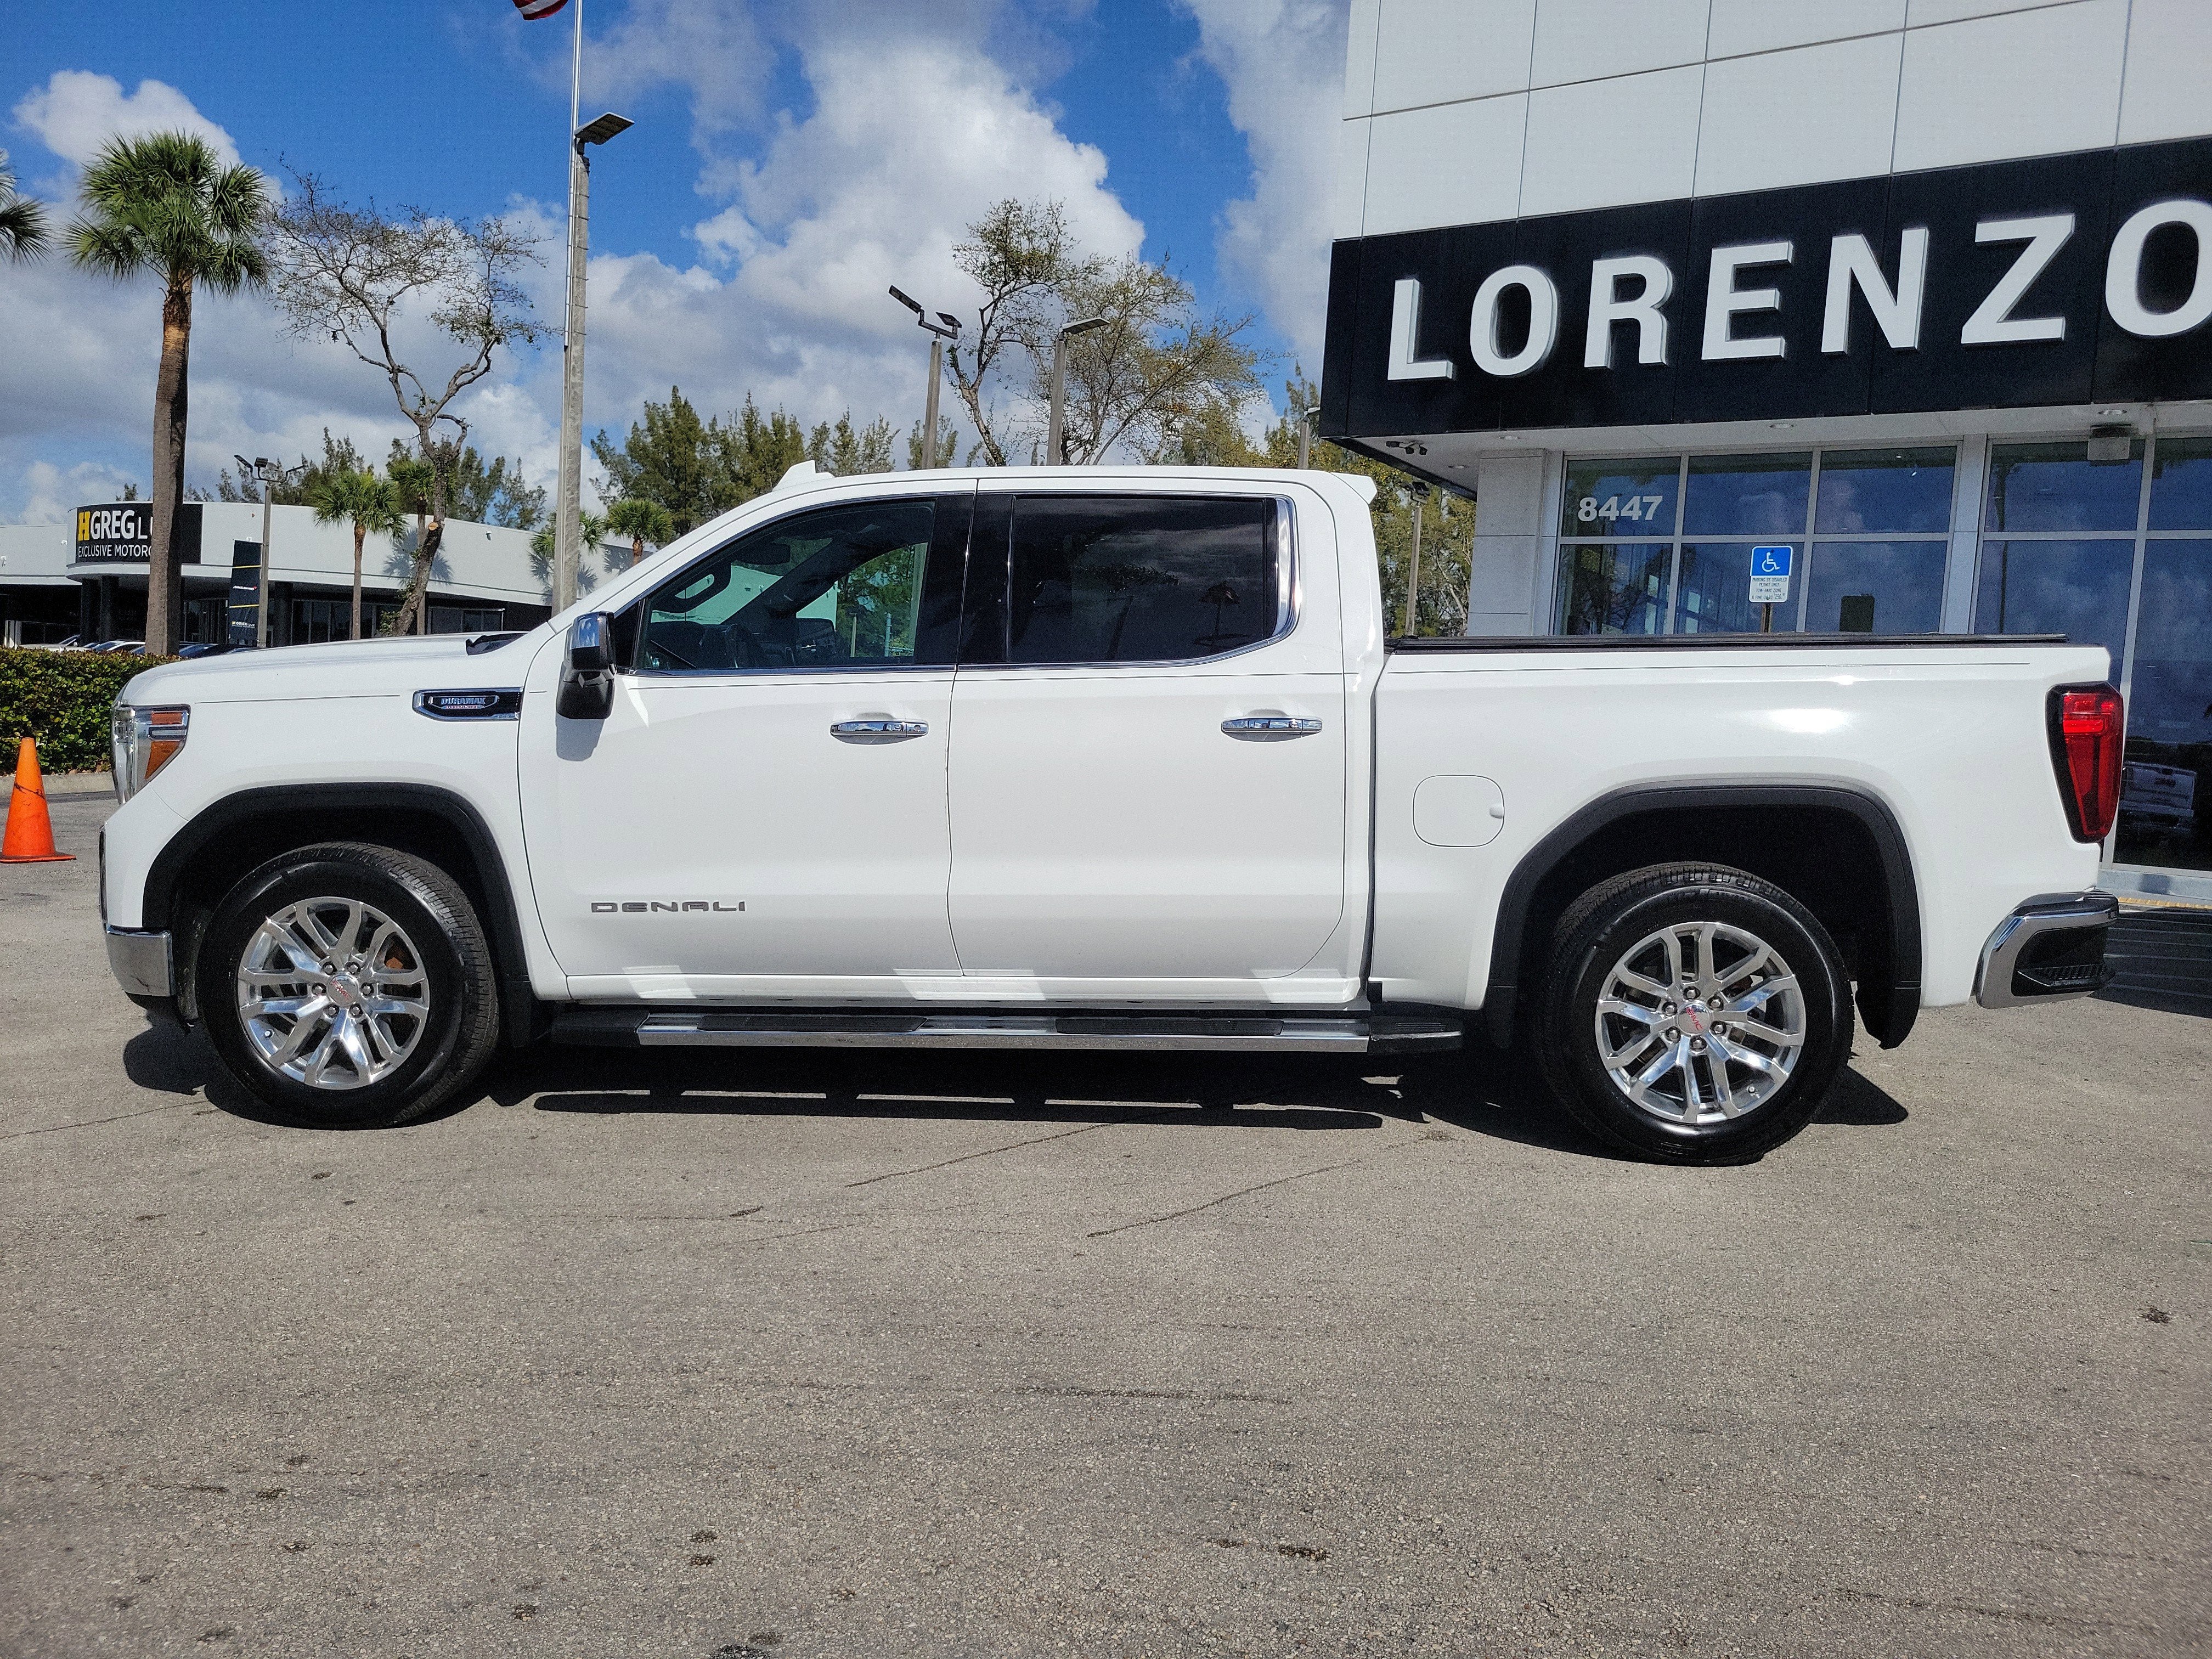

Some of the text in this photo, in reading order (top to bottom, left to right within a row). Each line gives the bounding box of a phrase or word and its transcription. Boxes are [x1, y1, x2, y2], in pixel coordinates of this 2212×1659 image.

[1387, 200, 2212, 381] LORENZO
[1578, 495, 1663, 522] 8447
[78, 510, 135, 541] HGREG
[78, 544, 112, 557] EXCLUSIVE
[591, 901, 746, 913] DENALI
[1686, 1007, 1703, 1031] GMC
